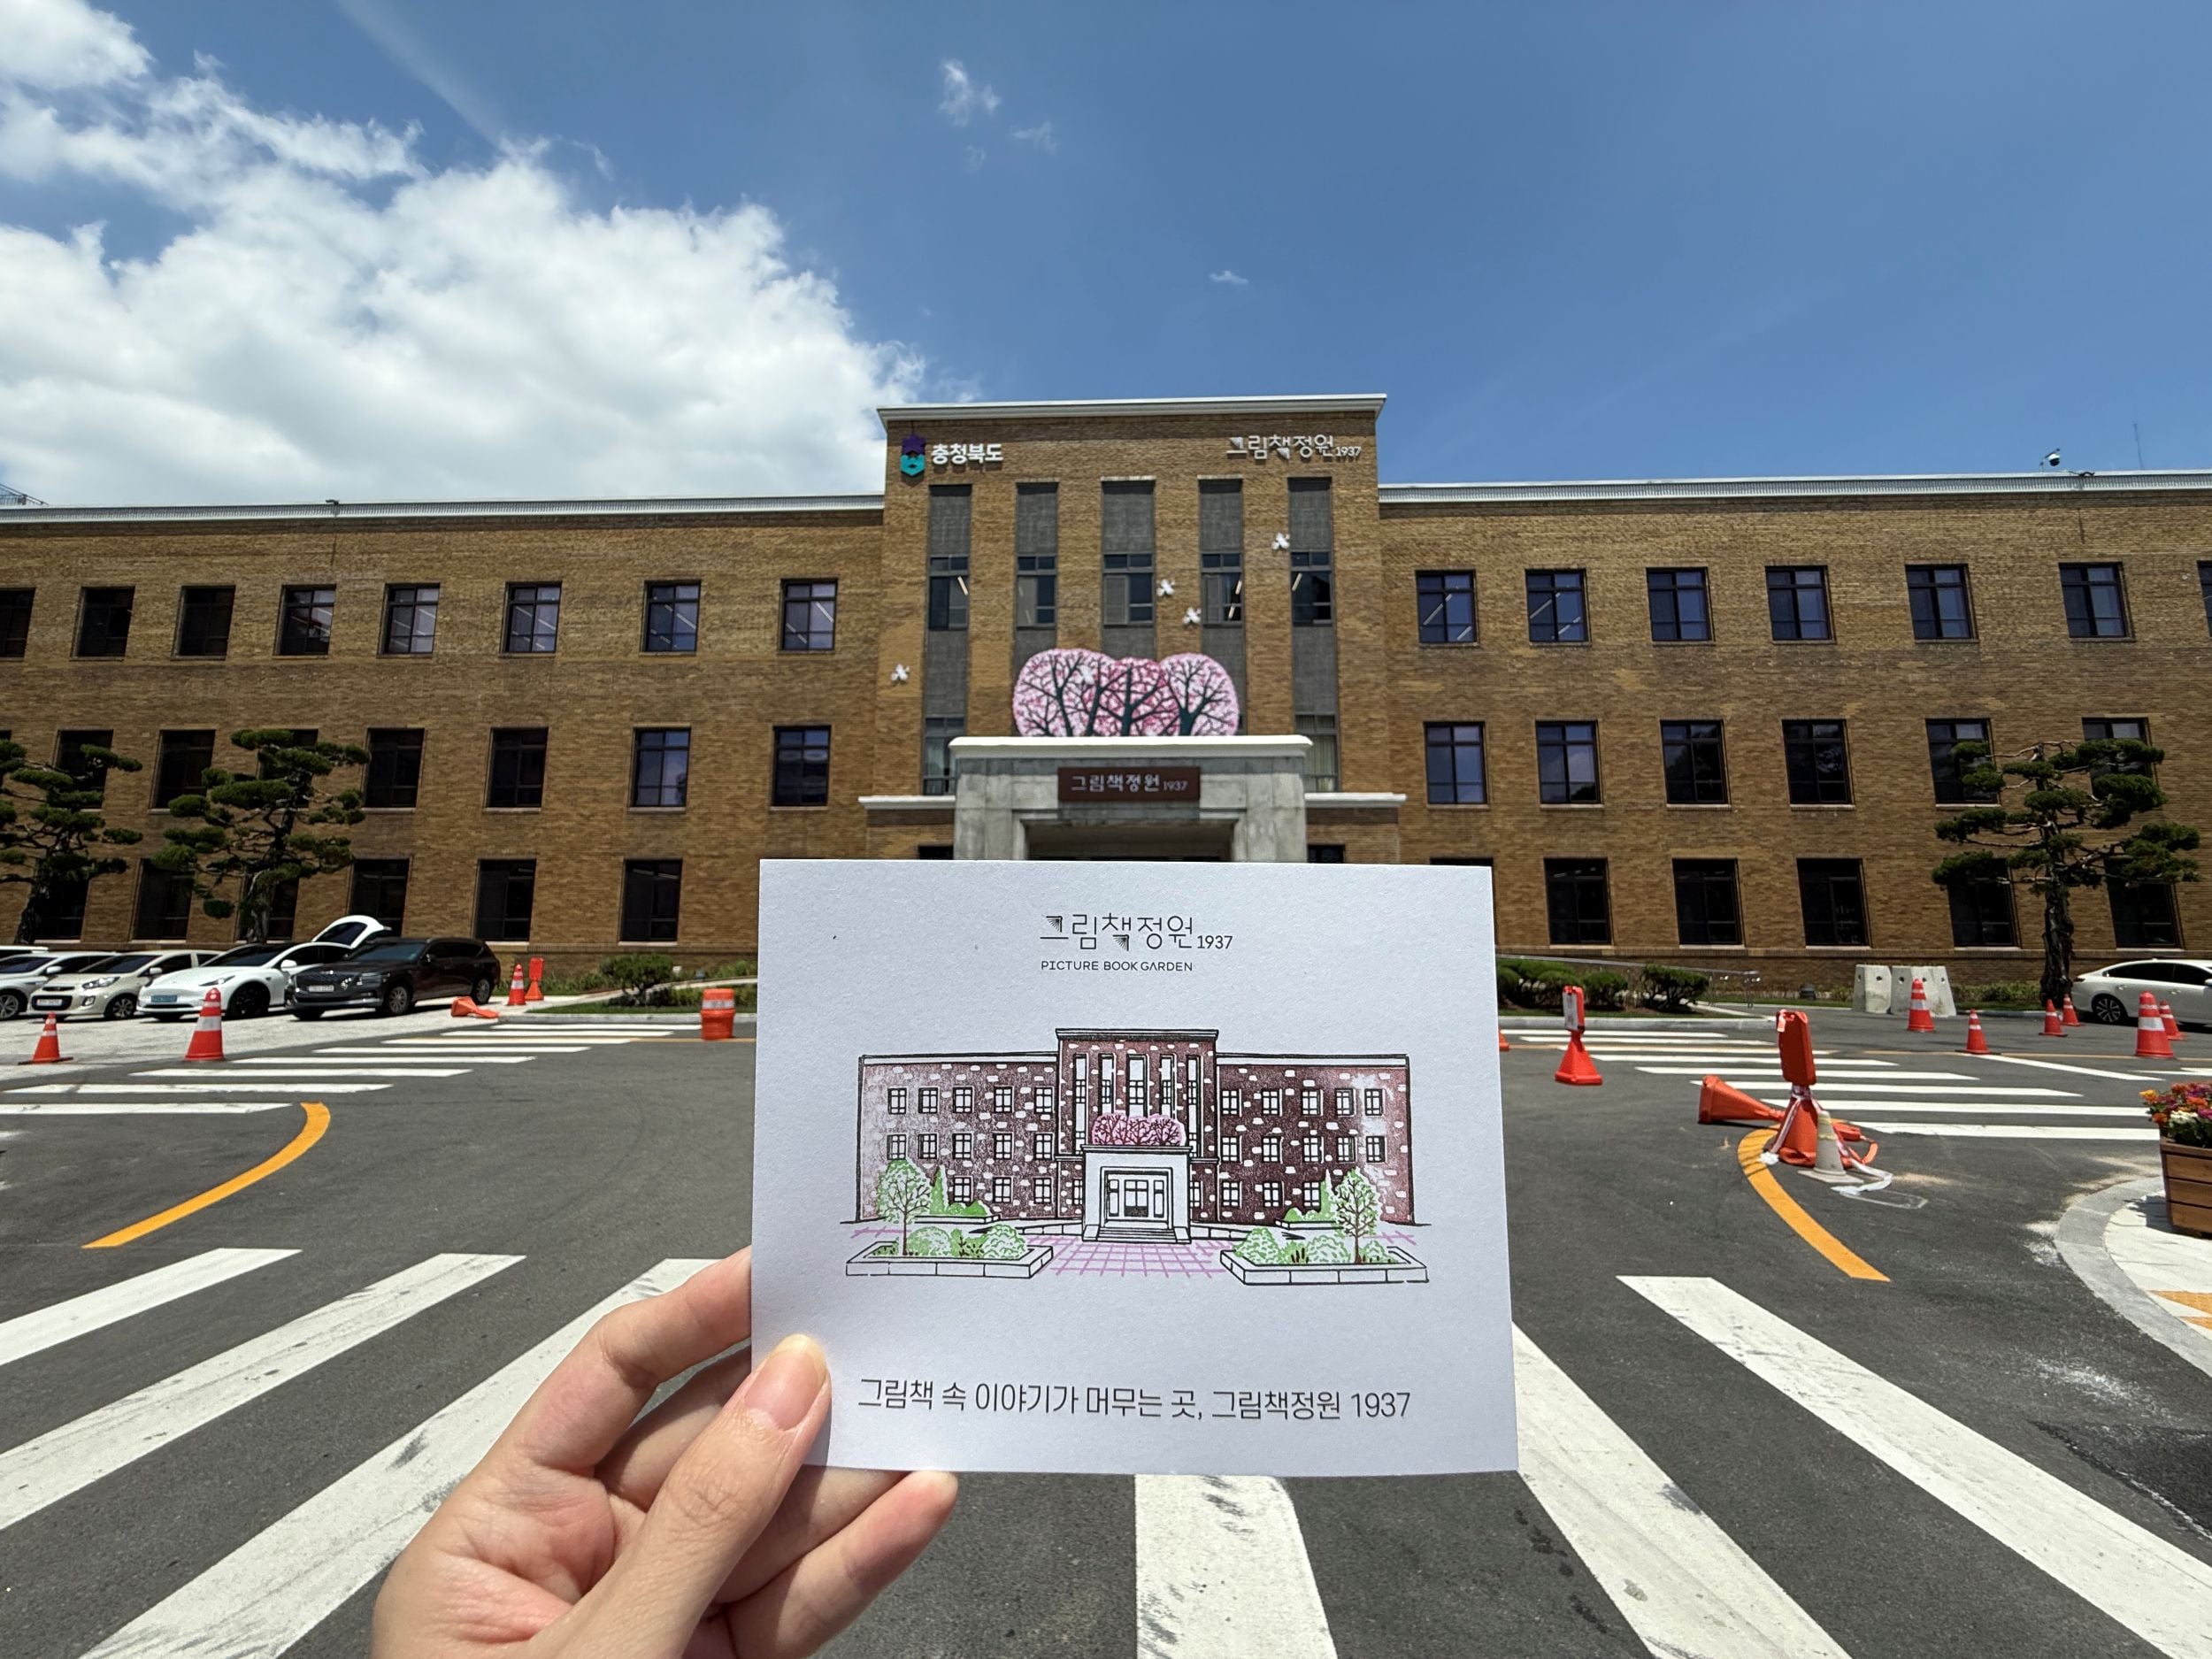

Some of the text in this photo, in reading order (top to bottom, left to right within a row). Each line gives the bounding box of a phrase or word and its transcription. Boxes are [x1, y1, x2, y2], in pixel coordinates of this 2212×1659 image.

[931, 443, 1003, 465] 충청북도
[1226, 434, 1362, 460] 그림책정원 1937
[1071, 773, 1188, 793] 그림책정원 1937
[1040, 912, 1233, 951] 그림책정원 1937
[1041, 960, 1193, 972] PICTURE BOOK GARDEN
[858, 1379, 1411, 1420] 그림책 속 이야기가 머무는 곳, 그림책정원 1937
